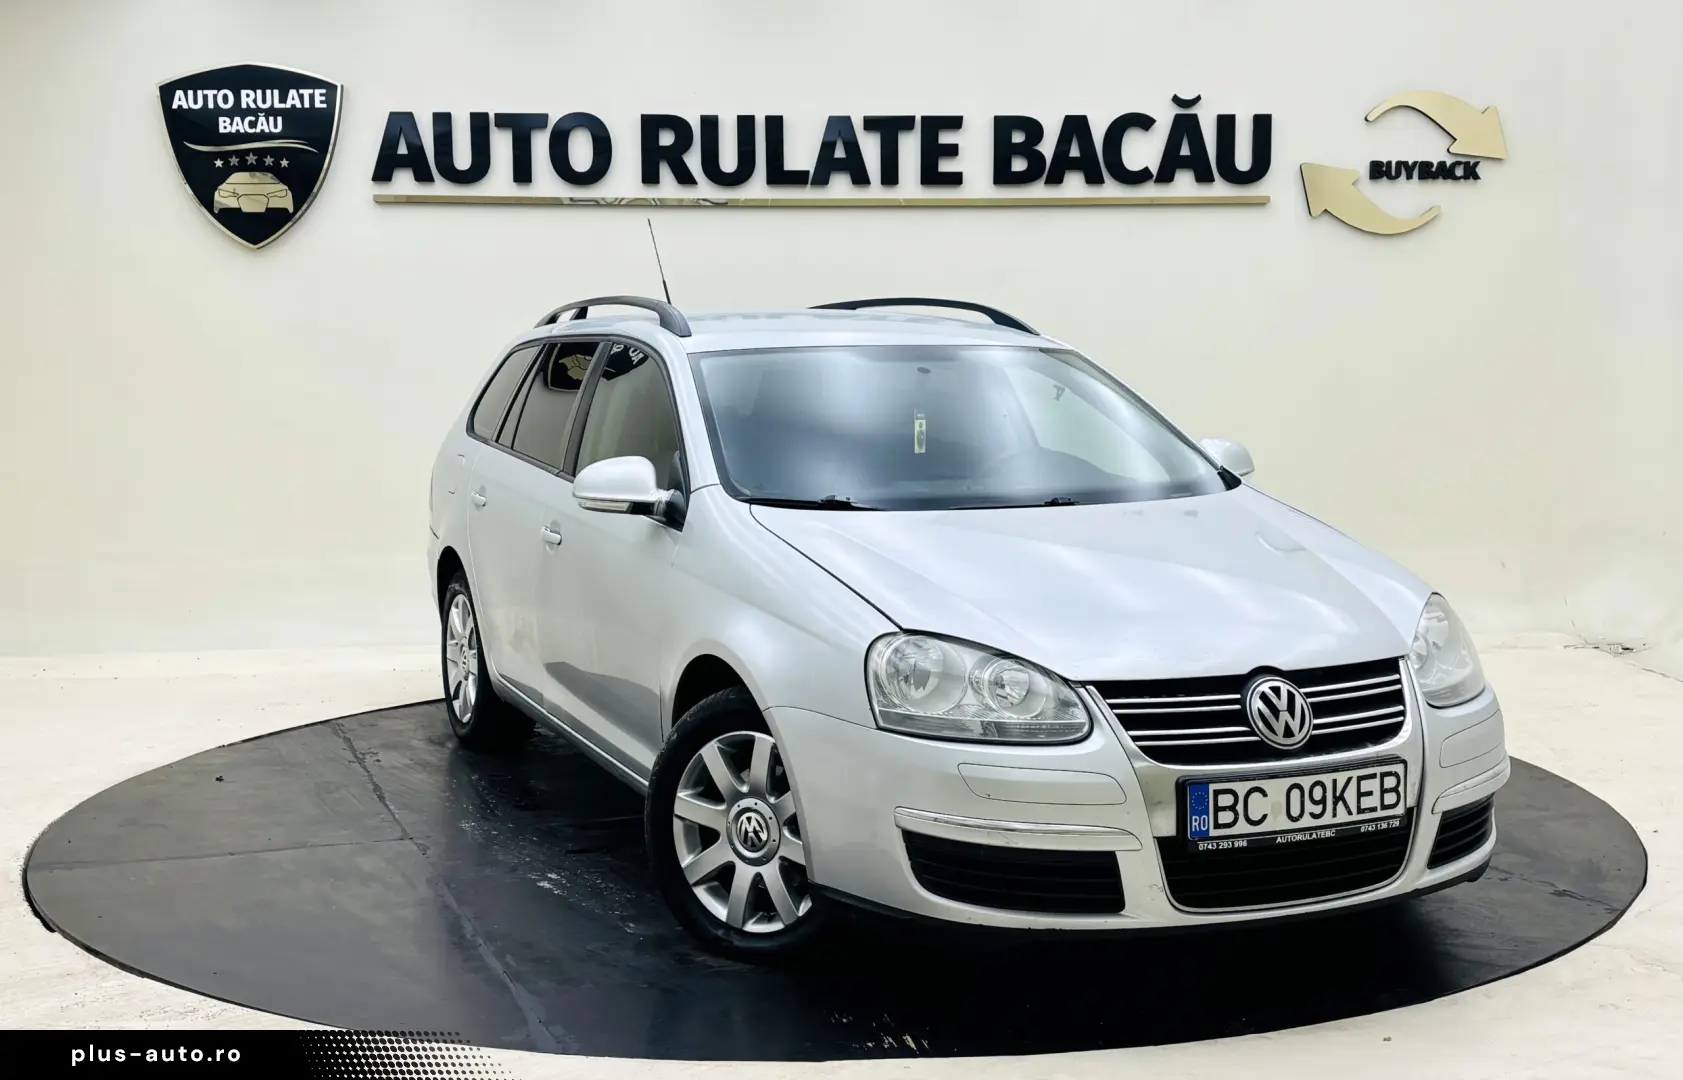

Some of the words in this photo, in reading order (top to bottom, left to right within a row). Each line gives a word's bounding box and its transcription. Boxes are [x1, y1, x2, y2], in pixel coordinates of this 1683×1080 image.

[171, 89, 234, 109] AUTO
[240, 88, 327, 109] RULATE
[218, 113, 283, 134] BACĂU
[371, 111, 613, 185] AUTO
[640, 113, 964, 187] RULATE
[993, 94, 1272, 186] BACĂU
[1369, 160, 1481, 182] BUYBACK
[1213, 786, 1268, 830] BC
[1285, 771, 1402, 823] 09KEB
[1191, 815, 1209, 832] RO
[1360, 824, 1376, 833] 0743
[1198, 842, 1217, 851] 0743
[1218, 841, 1233, 849] 293
[1233, 840, 1248, 848] 996
[1275, 830, 1336, 844] AUTORULATEBC
